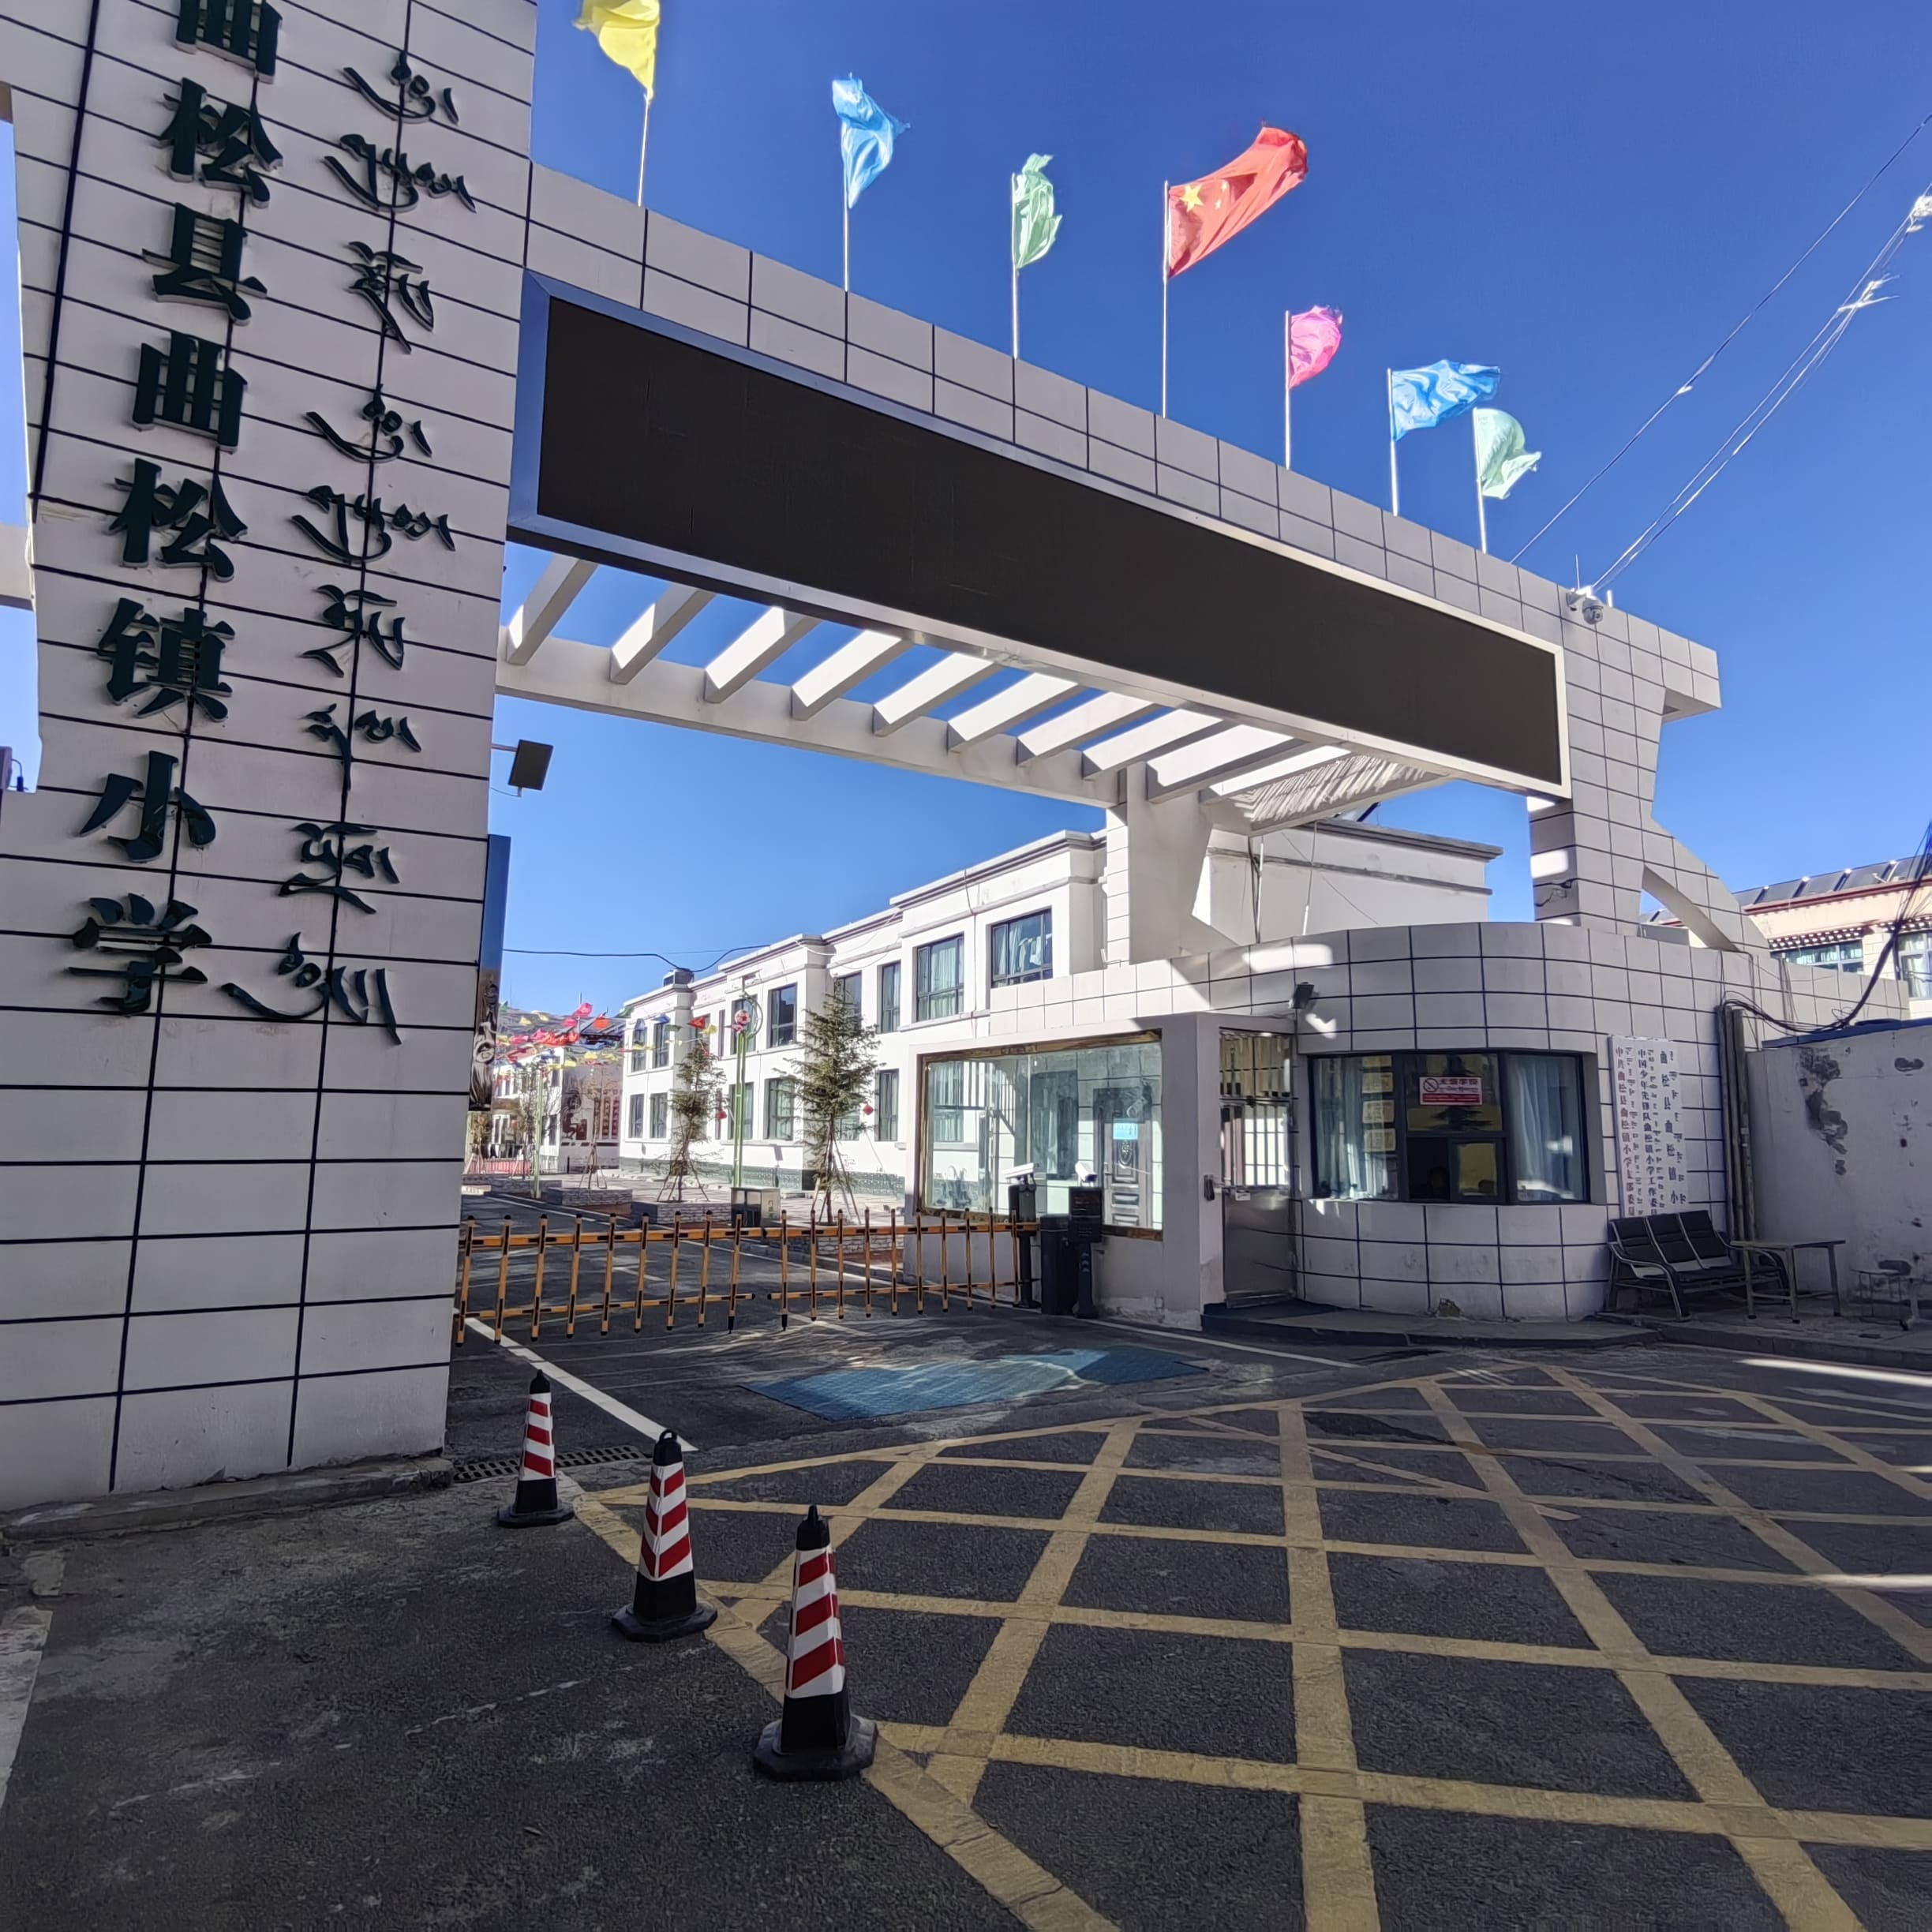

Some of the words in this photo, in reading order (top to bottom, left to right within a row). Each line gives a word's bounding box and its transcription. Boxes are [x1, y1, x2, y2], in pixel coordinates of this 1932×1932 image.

[68, 0, 283, 1017] 曲松县曲松镇小学
